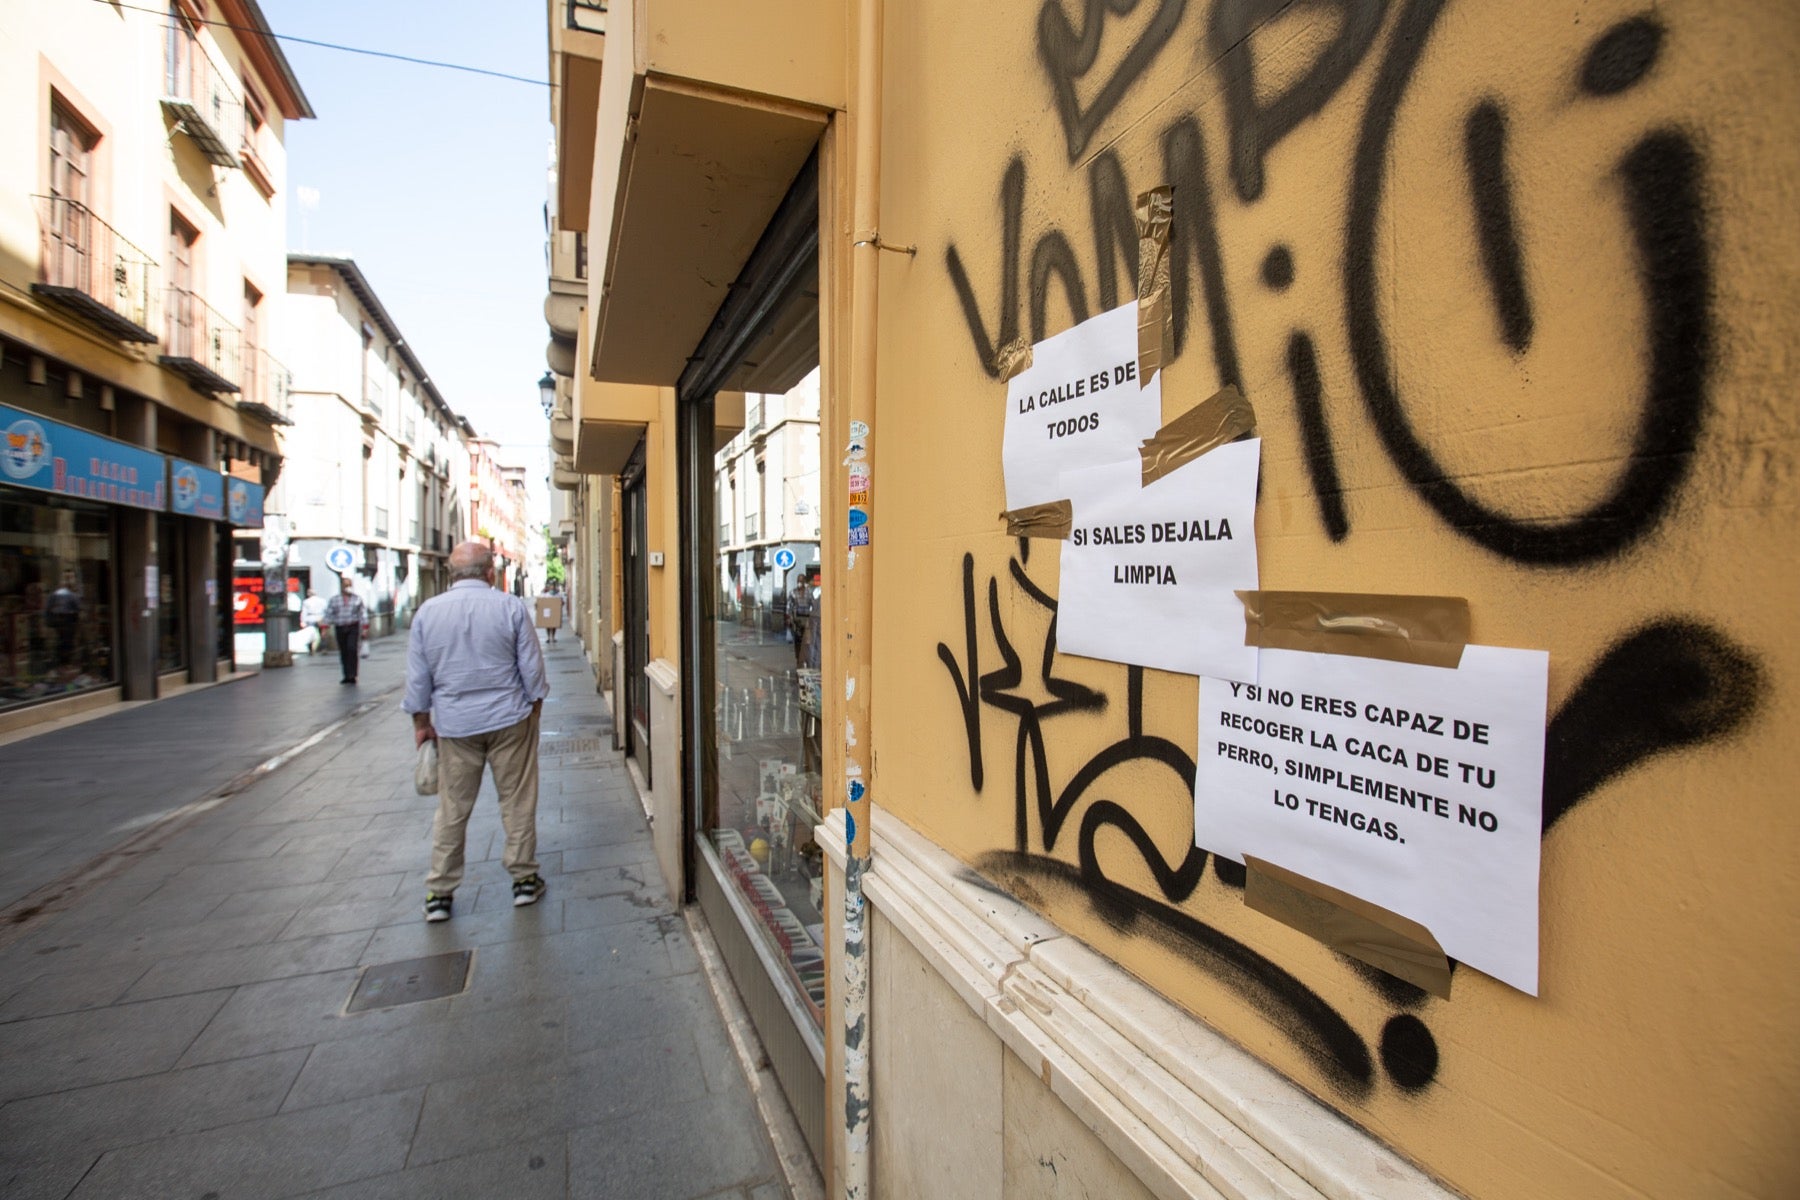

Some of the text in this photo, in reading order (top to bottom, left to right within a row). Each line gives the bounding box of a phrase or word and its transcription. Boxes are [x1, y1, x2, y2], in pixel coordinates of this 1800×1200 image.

[1020, 361, 1135, 414] LA CALLE ES DE
[1048, 413, 1098, 439] TODOS
[1074, 519, 1232, 545] SI SALES DEJALA
[1114, 566, 1176, 585] LIMPIA
[1230, 682, 1489, 745] Y SI NO ERES CAPAZ DE
[1221, 712, 1495, 789] RECOGER LA CACA DE TU
[1218, 742, 1498, 832] PERRO, SIMPLEMENTE NO
[1275, 790, 1405, 844] LO TENGAS.
